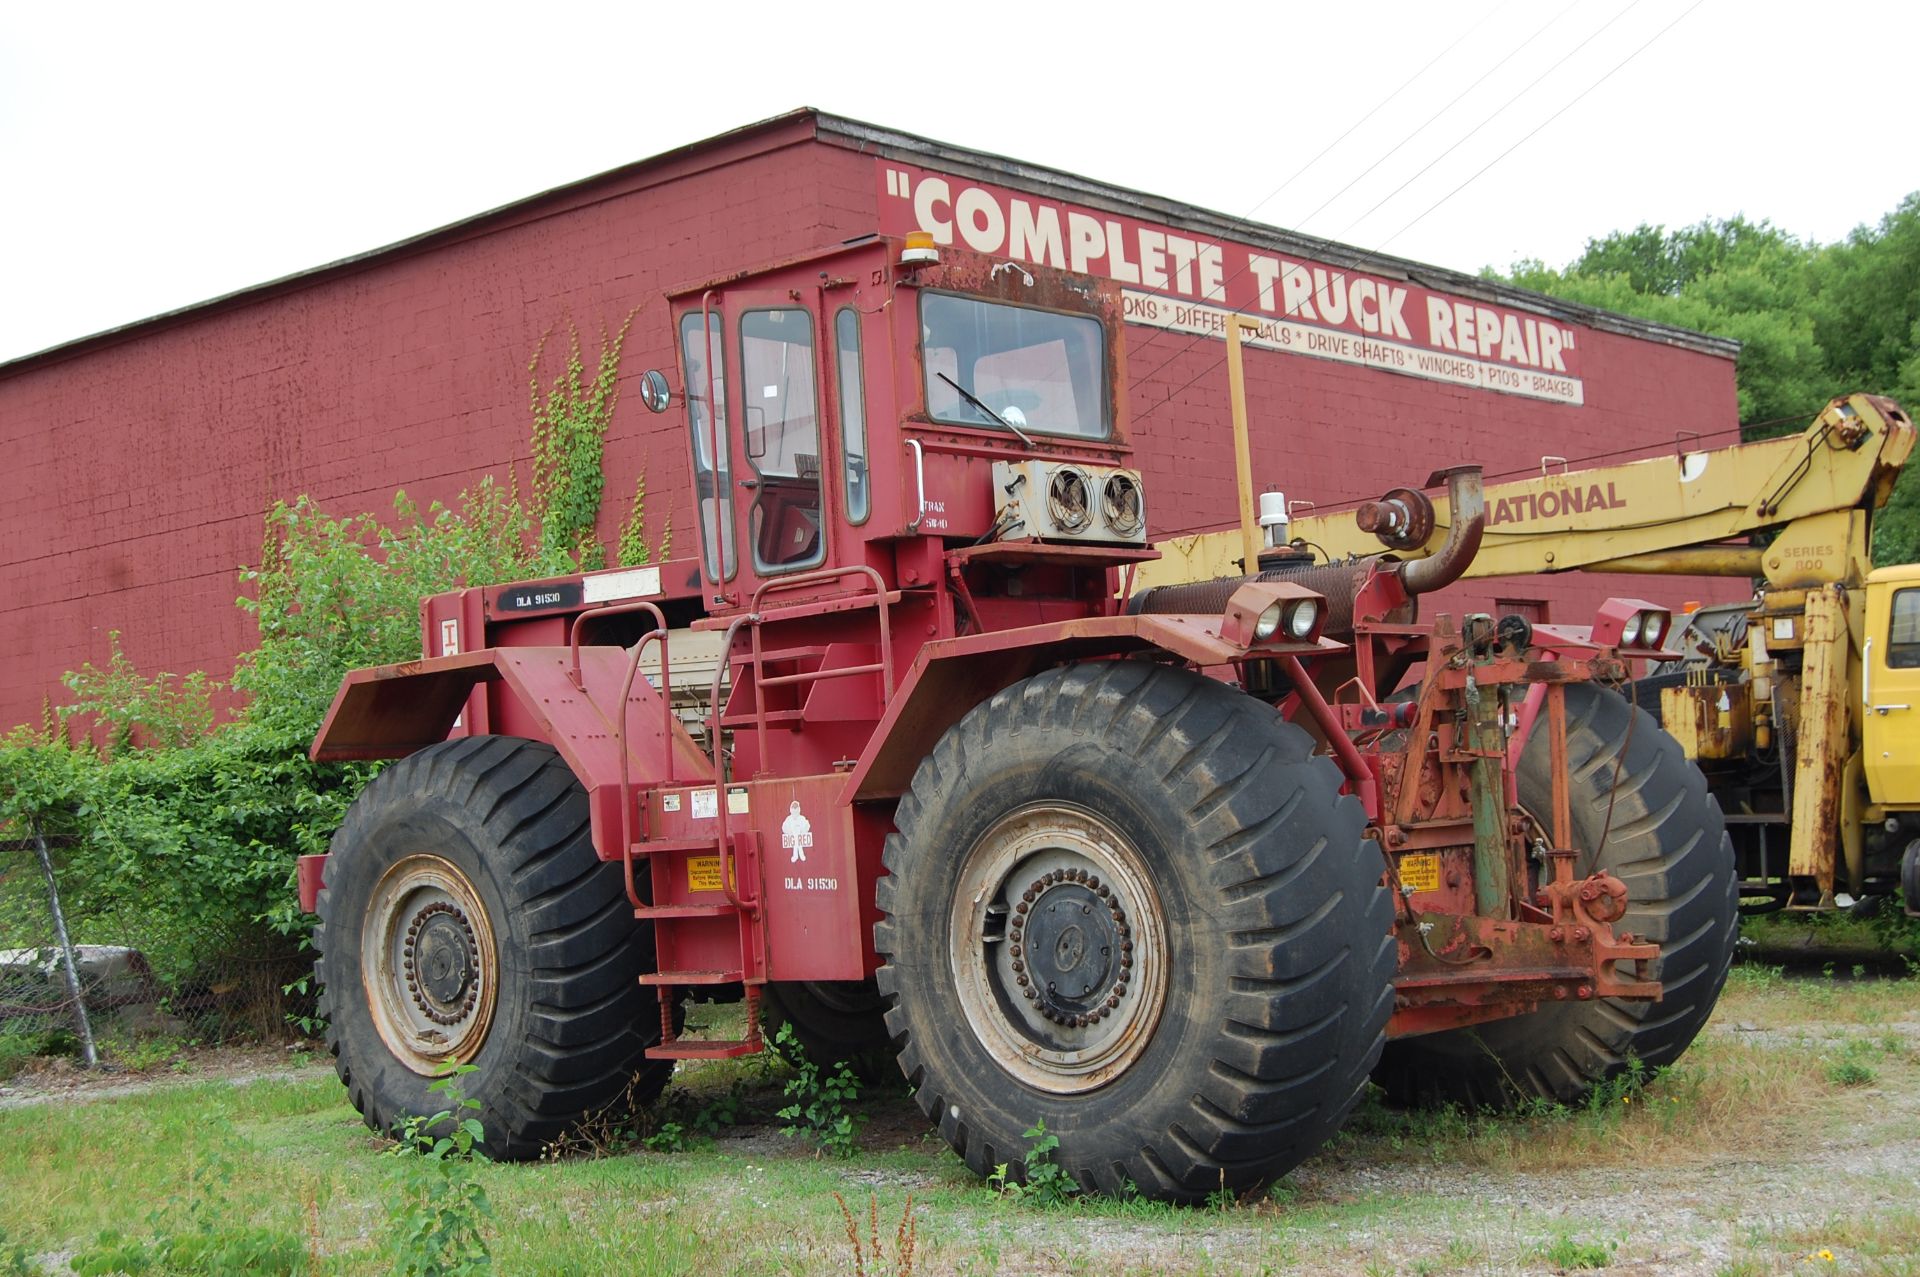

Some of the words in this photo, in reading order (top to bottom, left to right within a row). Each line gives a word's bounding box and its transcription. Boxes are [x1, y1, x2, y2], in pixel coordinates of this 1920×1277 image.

[886, 169, 1226, 302] "COMPLETE
[1248, 253, 1412, 340] TRUCK
[1426, 296, 1575, 372] REPAIR"
[1123, 296, 1158, 319] ONS
[1175, 306, 1291, 345] DIFFERNIALS
[1308, 332, 1350, 356] DRIVE
[1353, 341, 1405, 366] SHAFTS
[1416, 353, 1475, 380] WINCHES
[1488, 367, 1520, 387] PTO'S
[1532, 375, 1574, 397] BRAKES
[1784, 545, 1834, 558] SERIES
[516, 595, 532, 607] DLA
[535, 592, 561, 604] 91530
[783, 835, 796, 847] BIG
[798, 834, 812, 846] RED
[785, 877, 803, 890] DLA
[807, 878, 838, 891] 91530
